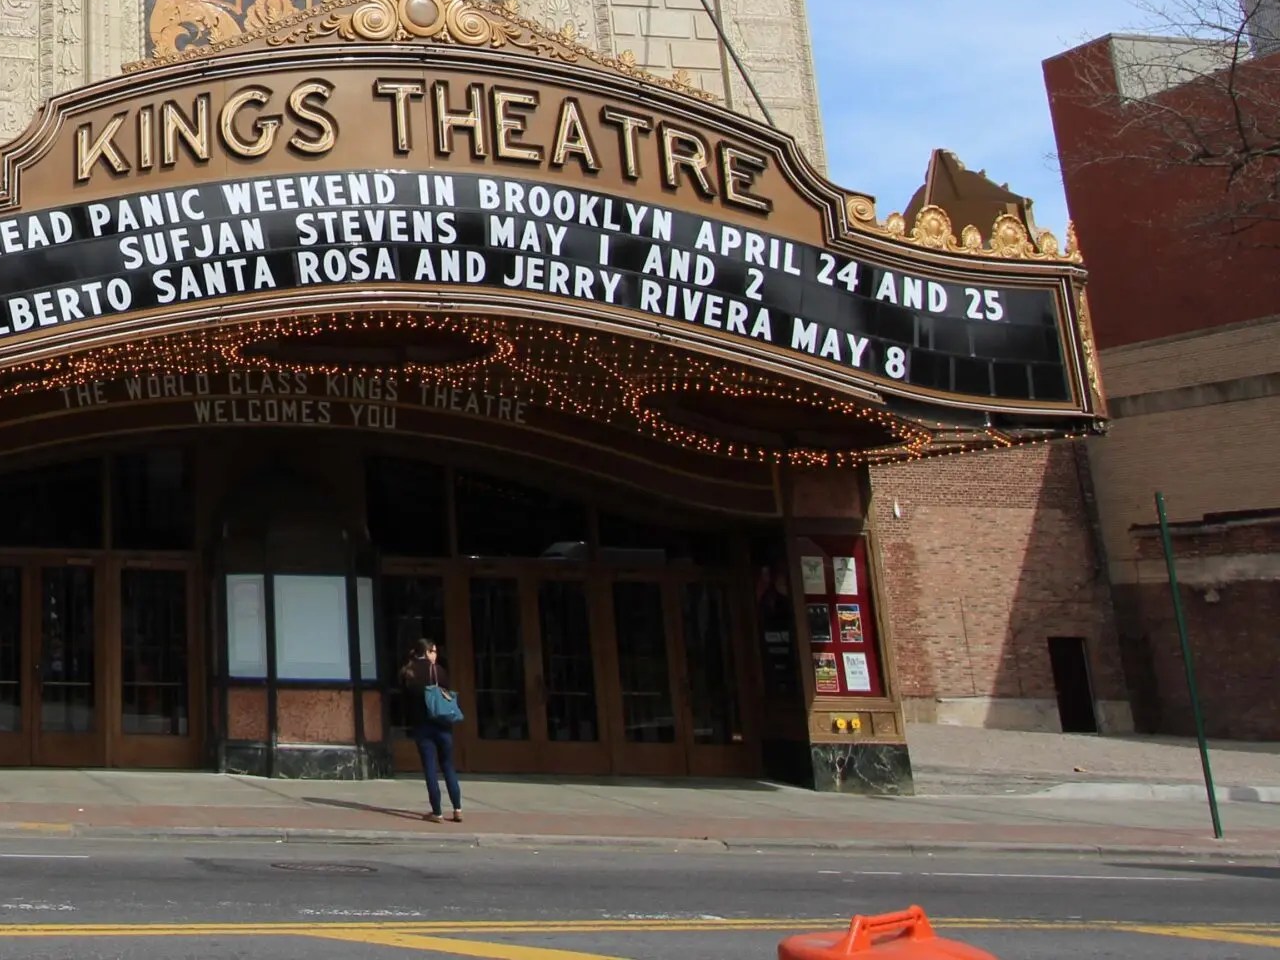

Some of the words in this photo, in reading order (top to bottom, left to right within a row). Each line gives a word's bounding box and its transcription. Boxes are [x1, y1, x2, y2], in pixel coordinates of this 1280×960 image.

[75, 78, 340, 181] KINGS
[375, 76, 773, 214] THEATRE
[88, 188, 205, 237] PANIC
[221, 171, 396, 215] WEEKEND
[418, 174, 455, 207] IN
[478, 178, 673, 242] BROOKLYN
[694, 220, 801, 276] APRIL
[817, 253, 859, 292] 24
[876, 271, 948, 313] AND
[965, 287, 1004, 321] 25
[119, 218, 265, 270] SUFJAN
[295, 209, 457, 246] STEVENS
[490, 215, 568, 256] MAY
[642, 244, 715, 286] AND
[745, 268, 764, 301] 2
[152, 256, 276, 303] SANTA
[297, 247, 396, 284] ROSA
[414, 249, 486, 283] AND
[503, 255, 622, 303] JERRY
[640, 279, 772, 341] RIVERA
[791, 317, 869, 367] MAY
[885, 346, 905, 379] 8
[60, 381, 108, 409] THE
[124, 374, 210, 401] WORLD
[228, 371, 308, 395] CLASS
[326, 373, 399, 402] KINGS
[420, 384, 528, 424] THEATRE
[194, 399, 332, 424] WELCOMES
[351, 406, 398, 429] YOU
